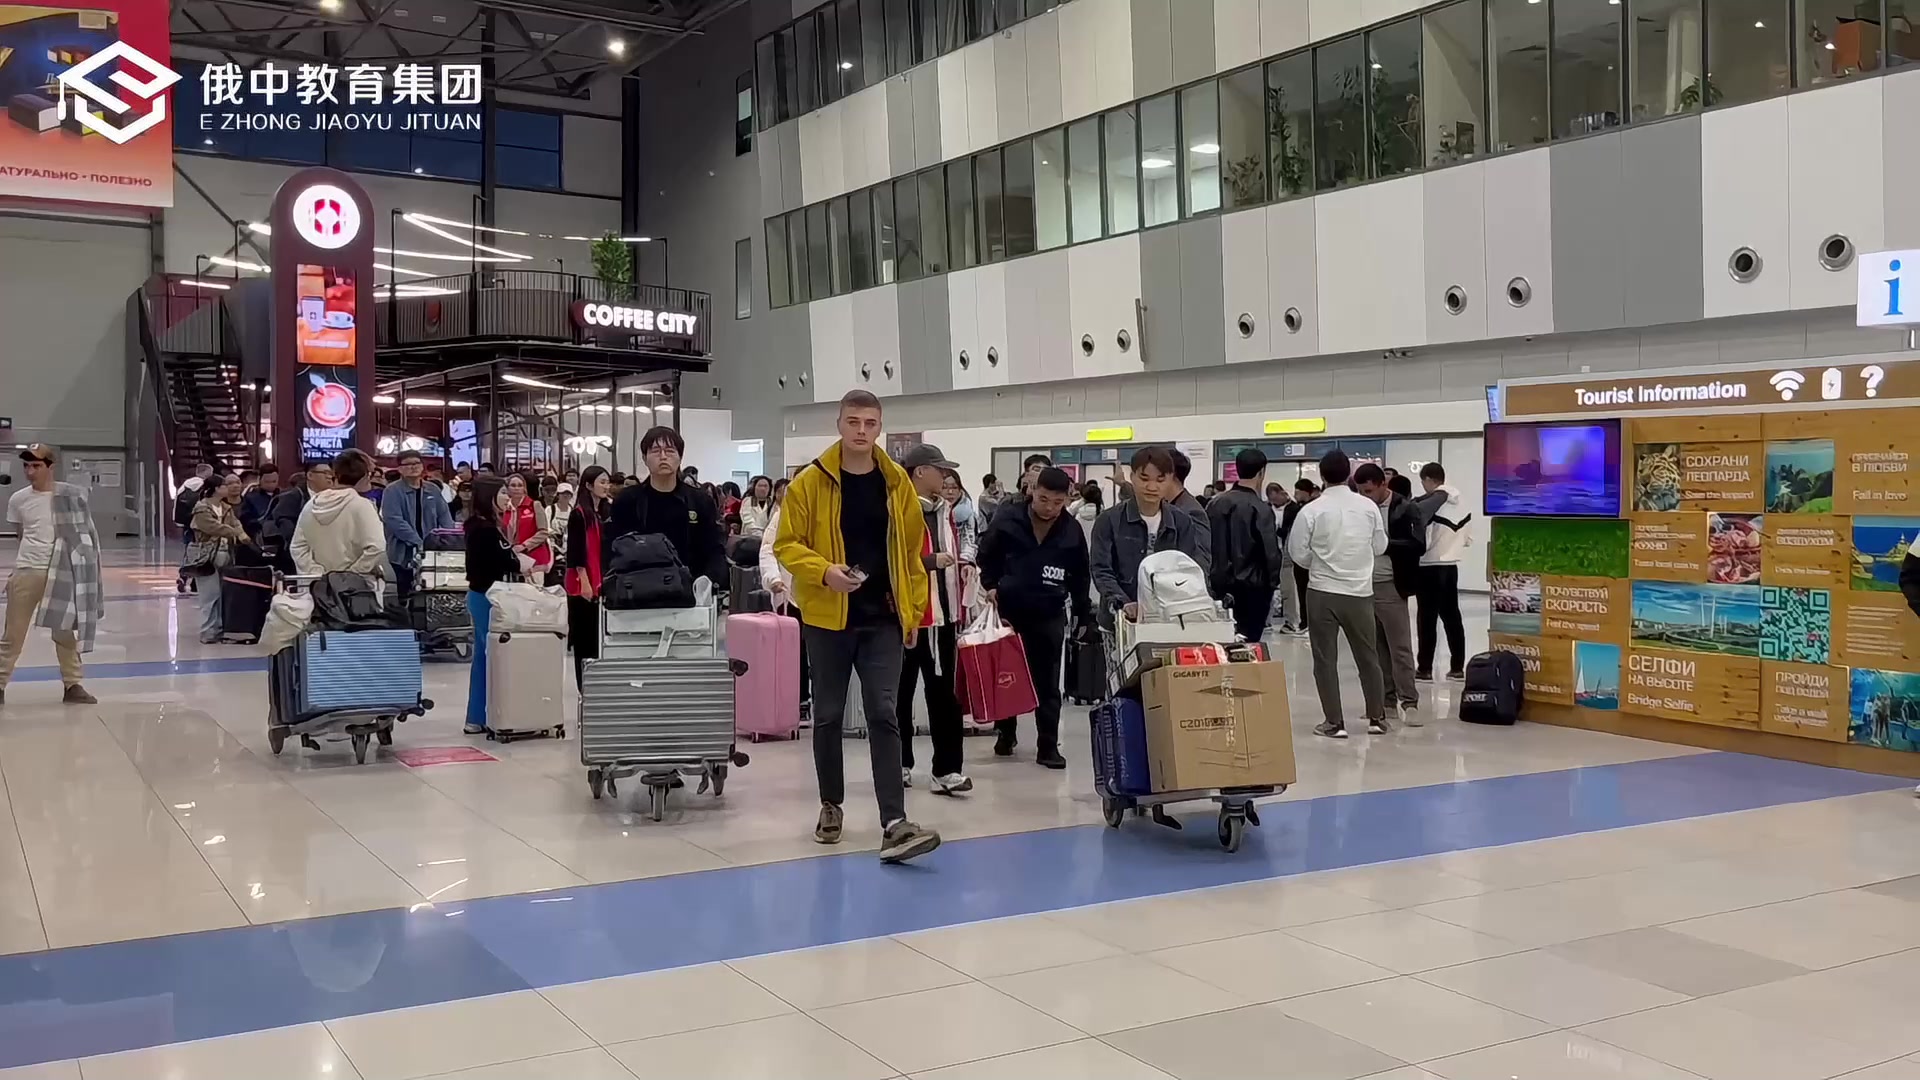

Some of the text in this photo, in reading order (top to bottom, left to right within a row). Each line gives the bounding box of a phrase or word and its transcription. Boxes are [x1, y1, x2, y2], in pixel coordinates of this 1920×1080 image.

[90, 173, 153, 187] ПОЛЕЗНО
[583, 302, 697, 335] COFFEE CITY
[1574, 381, 1747, 406] Tourist Information
[1686, 455, 1750, 468] СОХРАНИ
[1545, 598, 1609, 614] СКОРОСТЬ
[1628, 655, 1696, 677] СЕЛФИ
[1628, 673, 1694, 692] НА ВЫСОТЕ
[1627, 692, 1662, 708] Bridge
